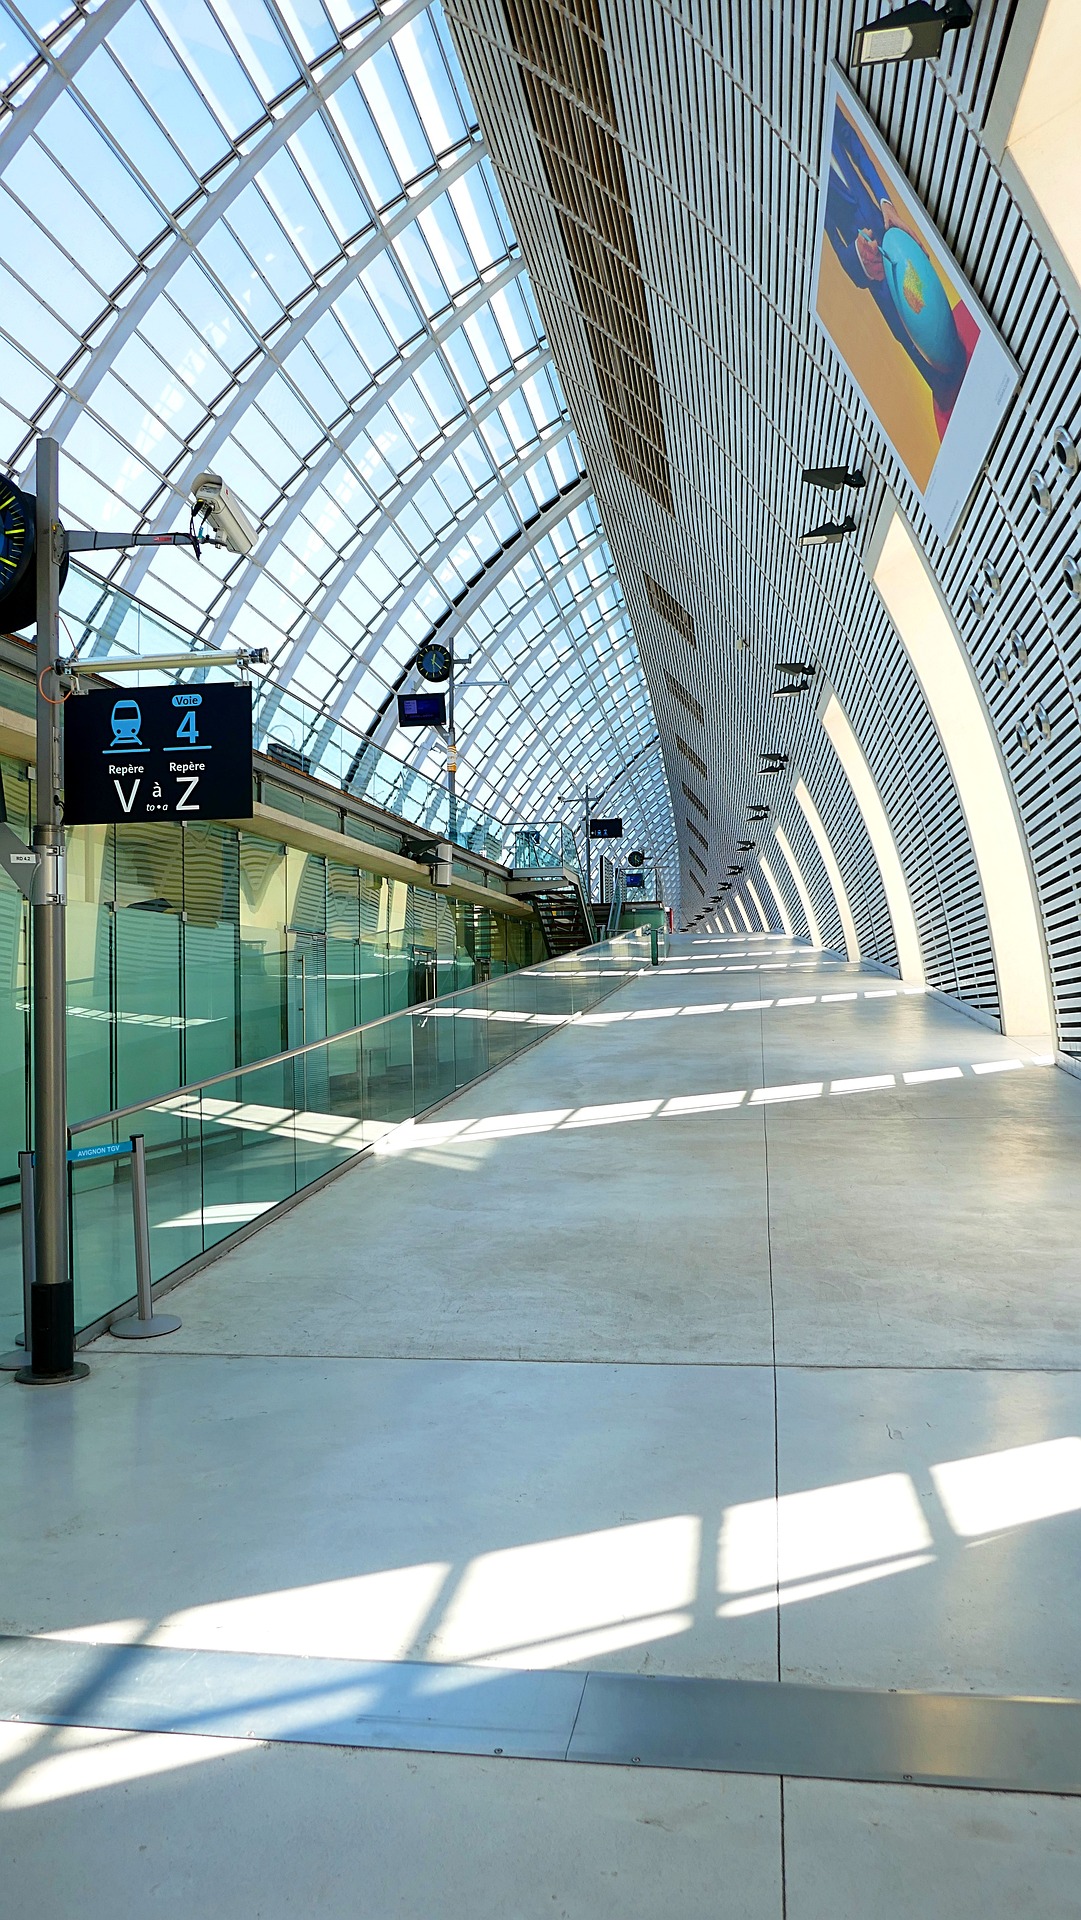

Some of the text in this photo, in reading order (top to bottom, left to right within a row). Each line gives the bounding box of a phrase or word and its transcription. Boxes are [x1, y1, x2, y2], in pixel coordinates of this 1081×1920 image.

[175, 695, 198, 706] Voie
[176, 710, 199, 744] 4
[108, 761, 206, 776] Repère Repère
[113, 776, 200, 813] V à Z
[77, 1147, 106, 1158] AVIGNON
